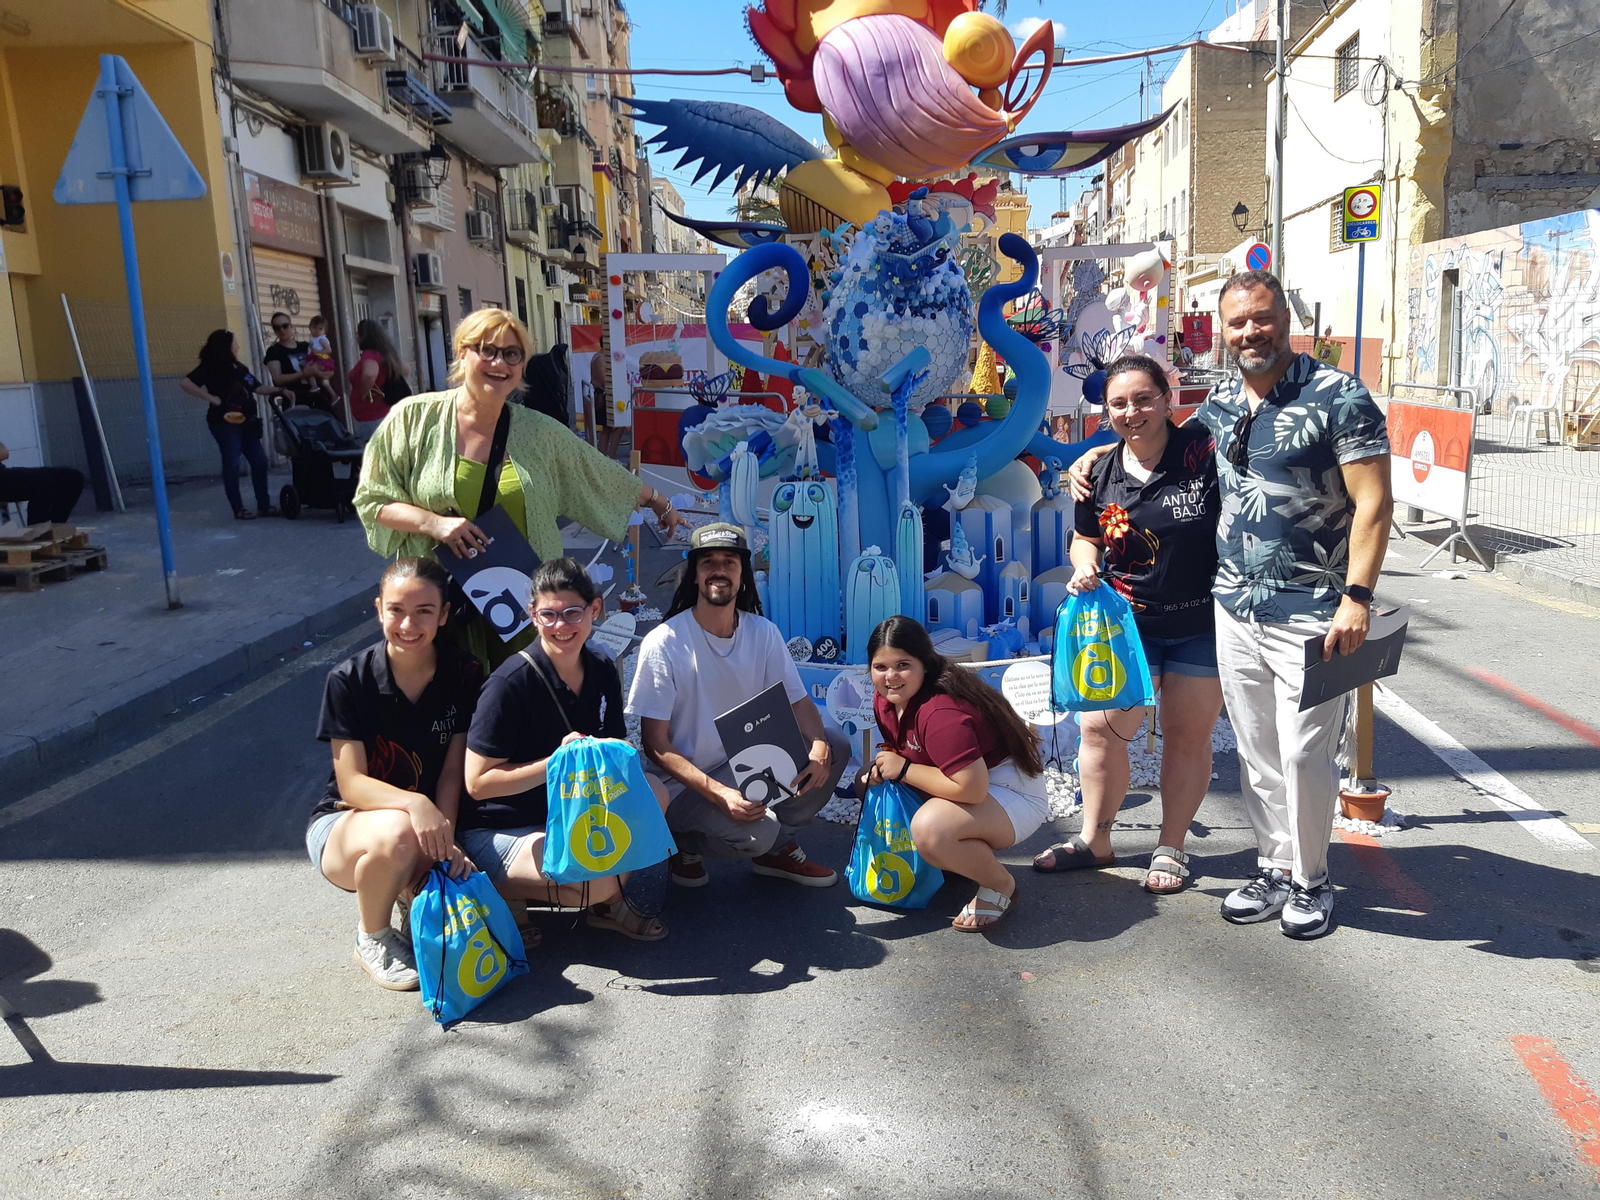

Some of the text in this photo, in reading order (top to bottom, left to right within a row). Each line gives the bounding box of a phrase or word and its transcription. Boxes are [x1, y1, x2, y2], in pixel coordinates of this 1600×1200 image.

[1414, 449, 1431, 461] AMSTEL
[1179, 477, 1204, 493] SAN
[1172, 503, 1206, 519] BAJO
[1163, 596, 1210, 612] 965 24 02 44
[816, 638, 833, 656] 400
[760, 713, 771, 724] Punt
[560, 782, 580, 799] LA
